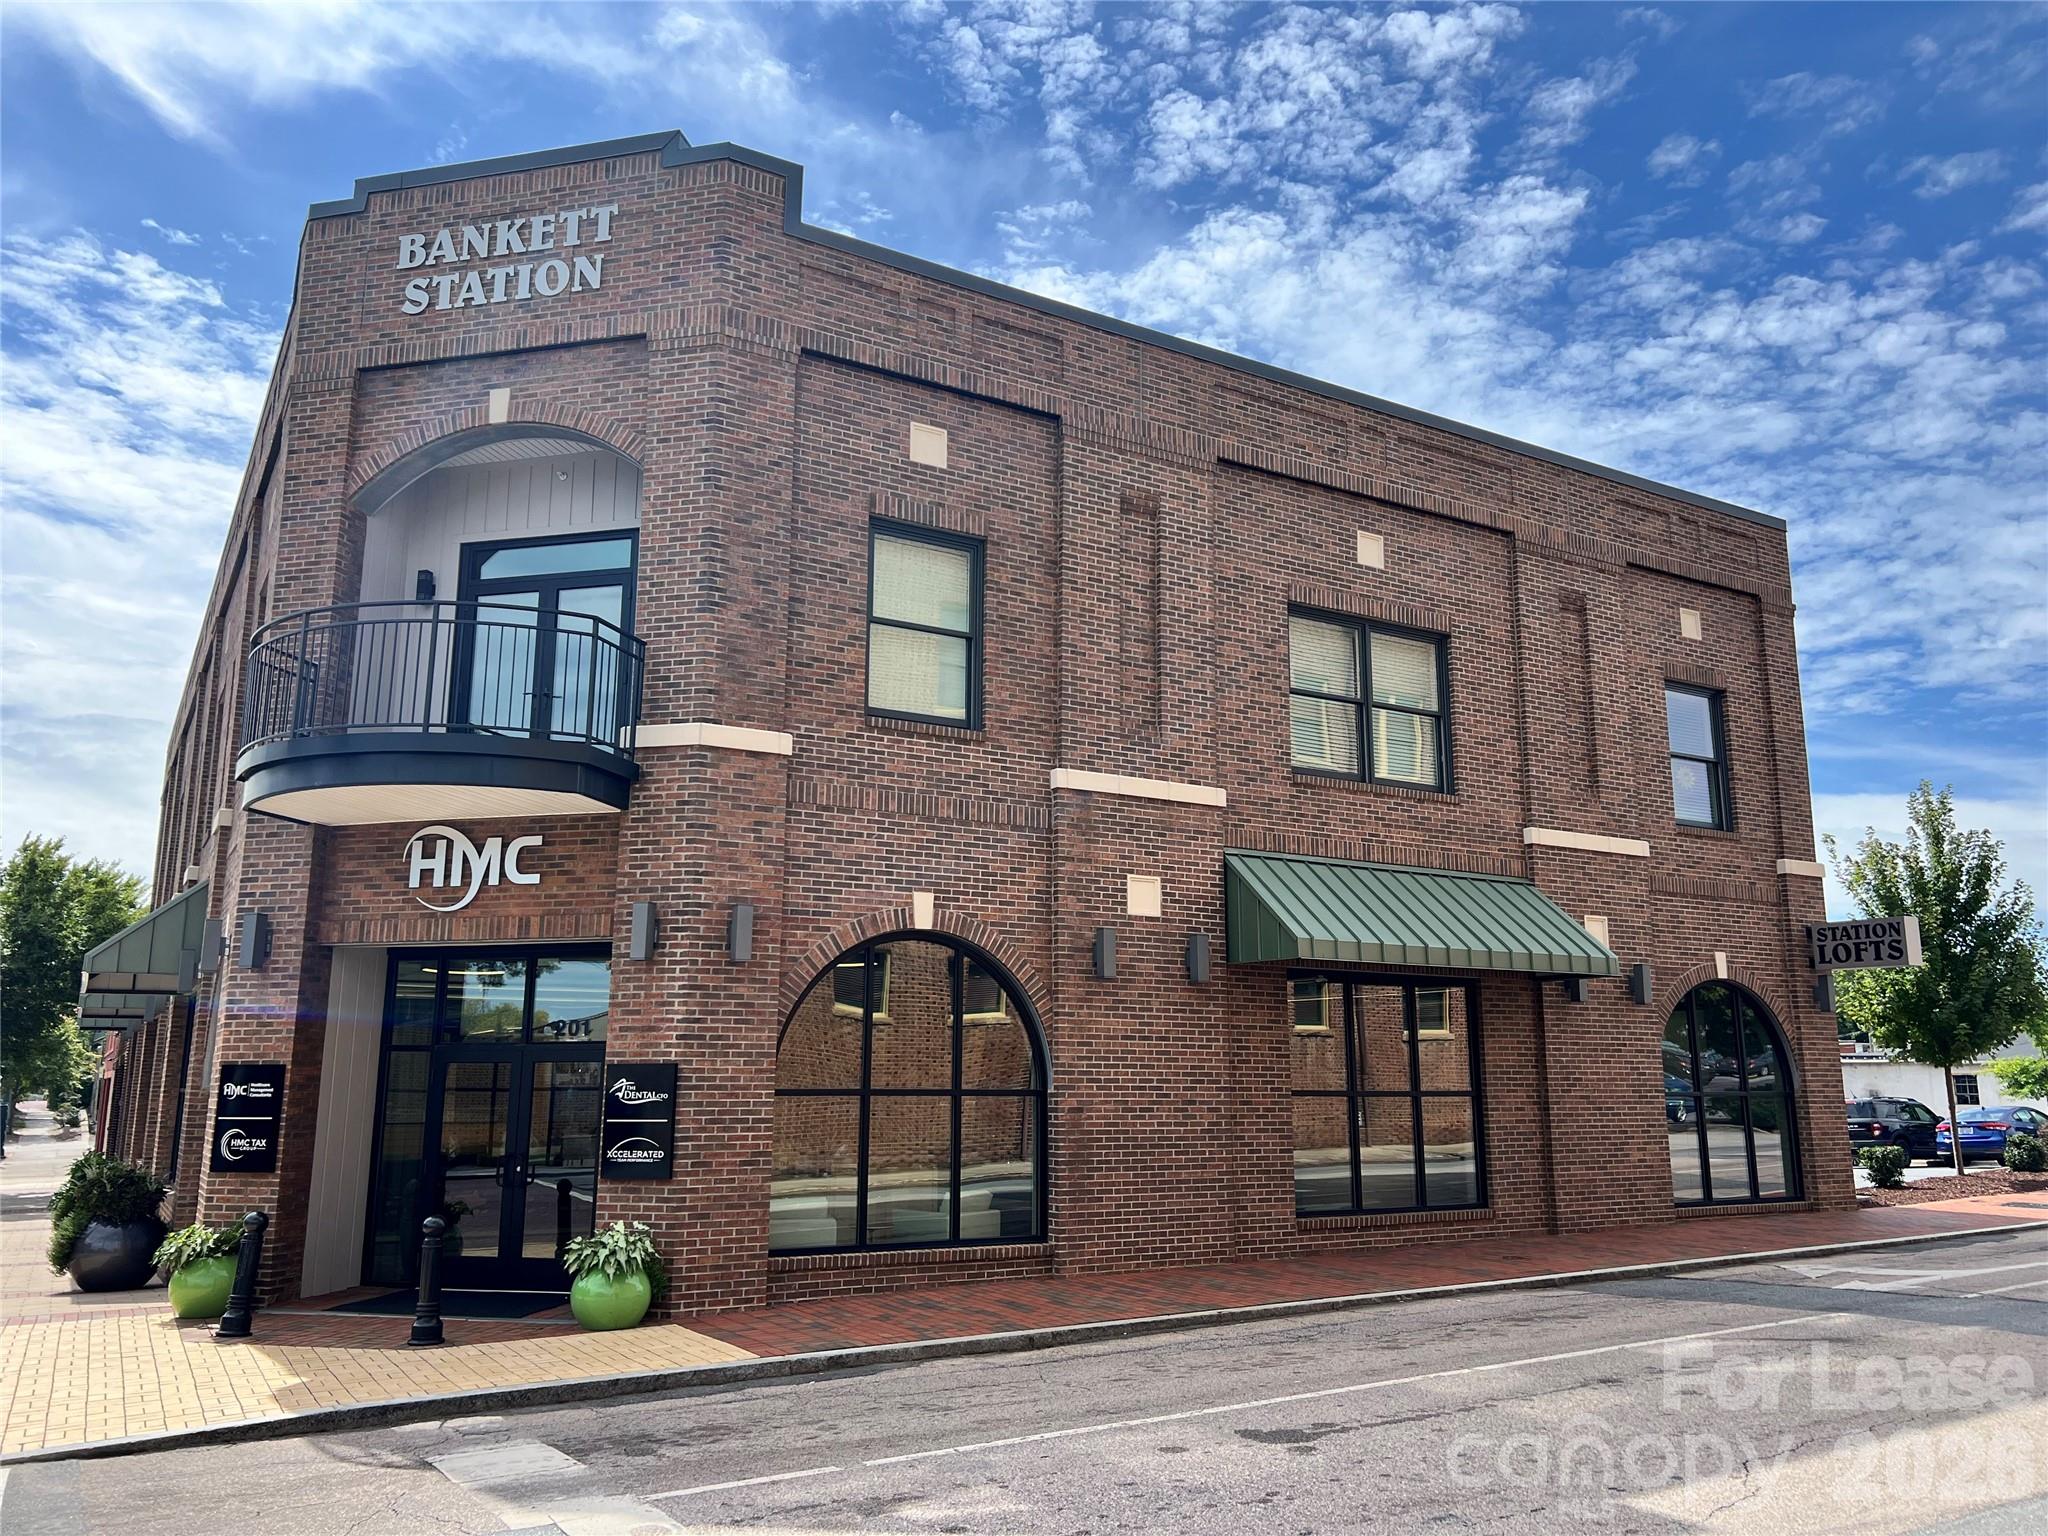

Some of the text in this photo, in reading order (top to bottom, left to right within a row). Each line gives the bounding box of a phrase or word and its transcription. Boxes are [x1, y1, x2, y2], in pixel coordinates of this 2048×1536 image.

[396, 203, 619, 269] BANKETT
[401, 254, 605, 314] STATION
[403, 825, 543, 912] HMC
[1816, 921, 1902, 942] STATION
[1816, 939, 1904, 964] LOFTS
[552, 1019, 591, 1037] 201
[223, 1083, 247, 1099] HMC
[230, 1138, 267, 1146] HMC TAX
[606, 1150, 665, 1159] XCCELERATED
